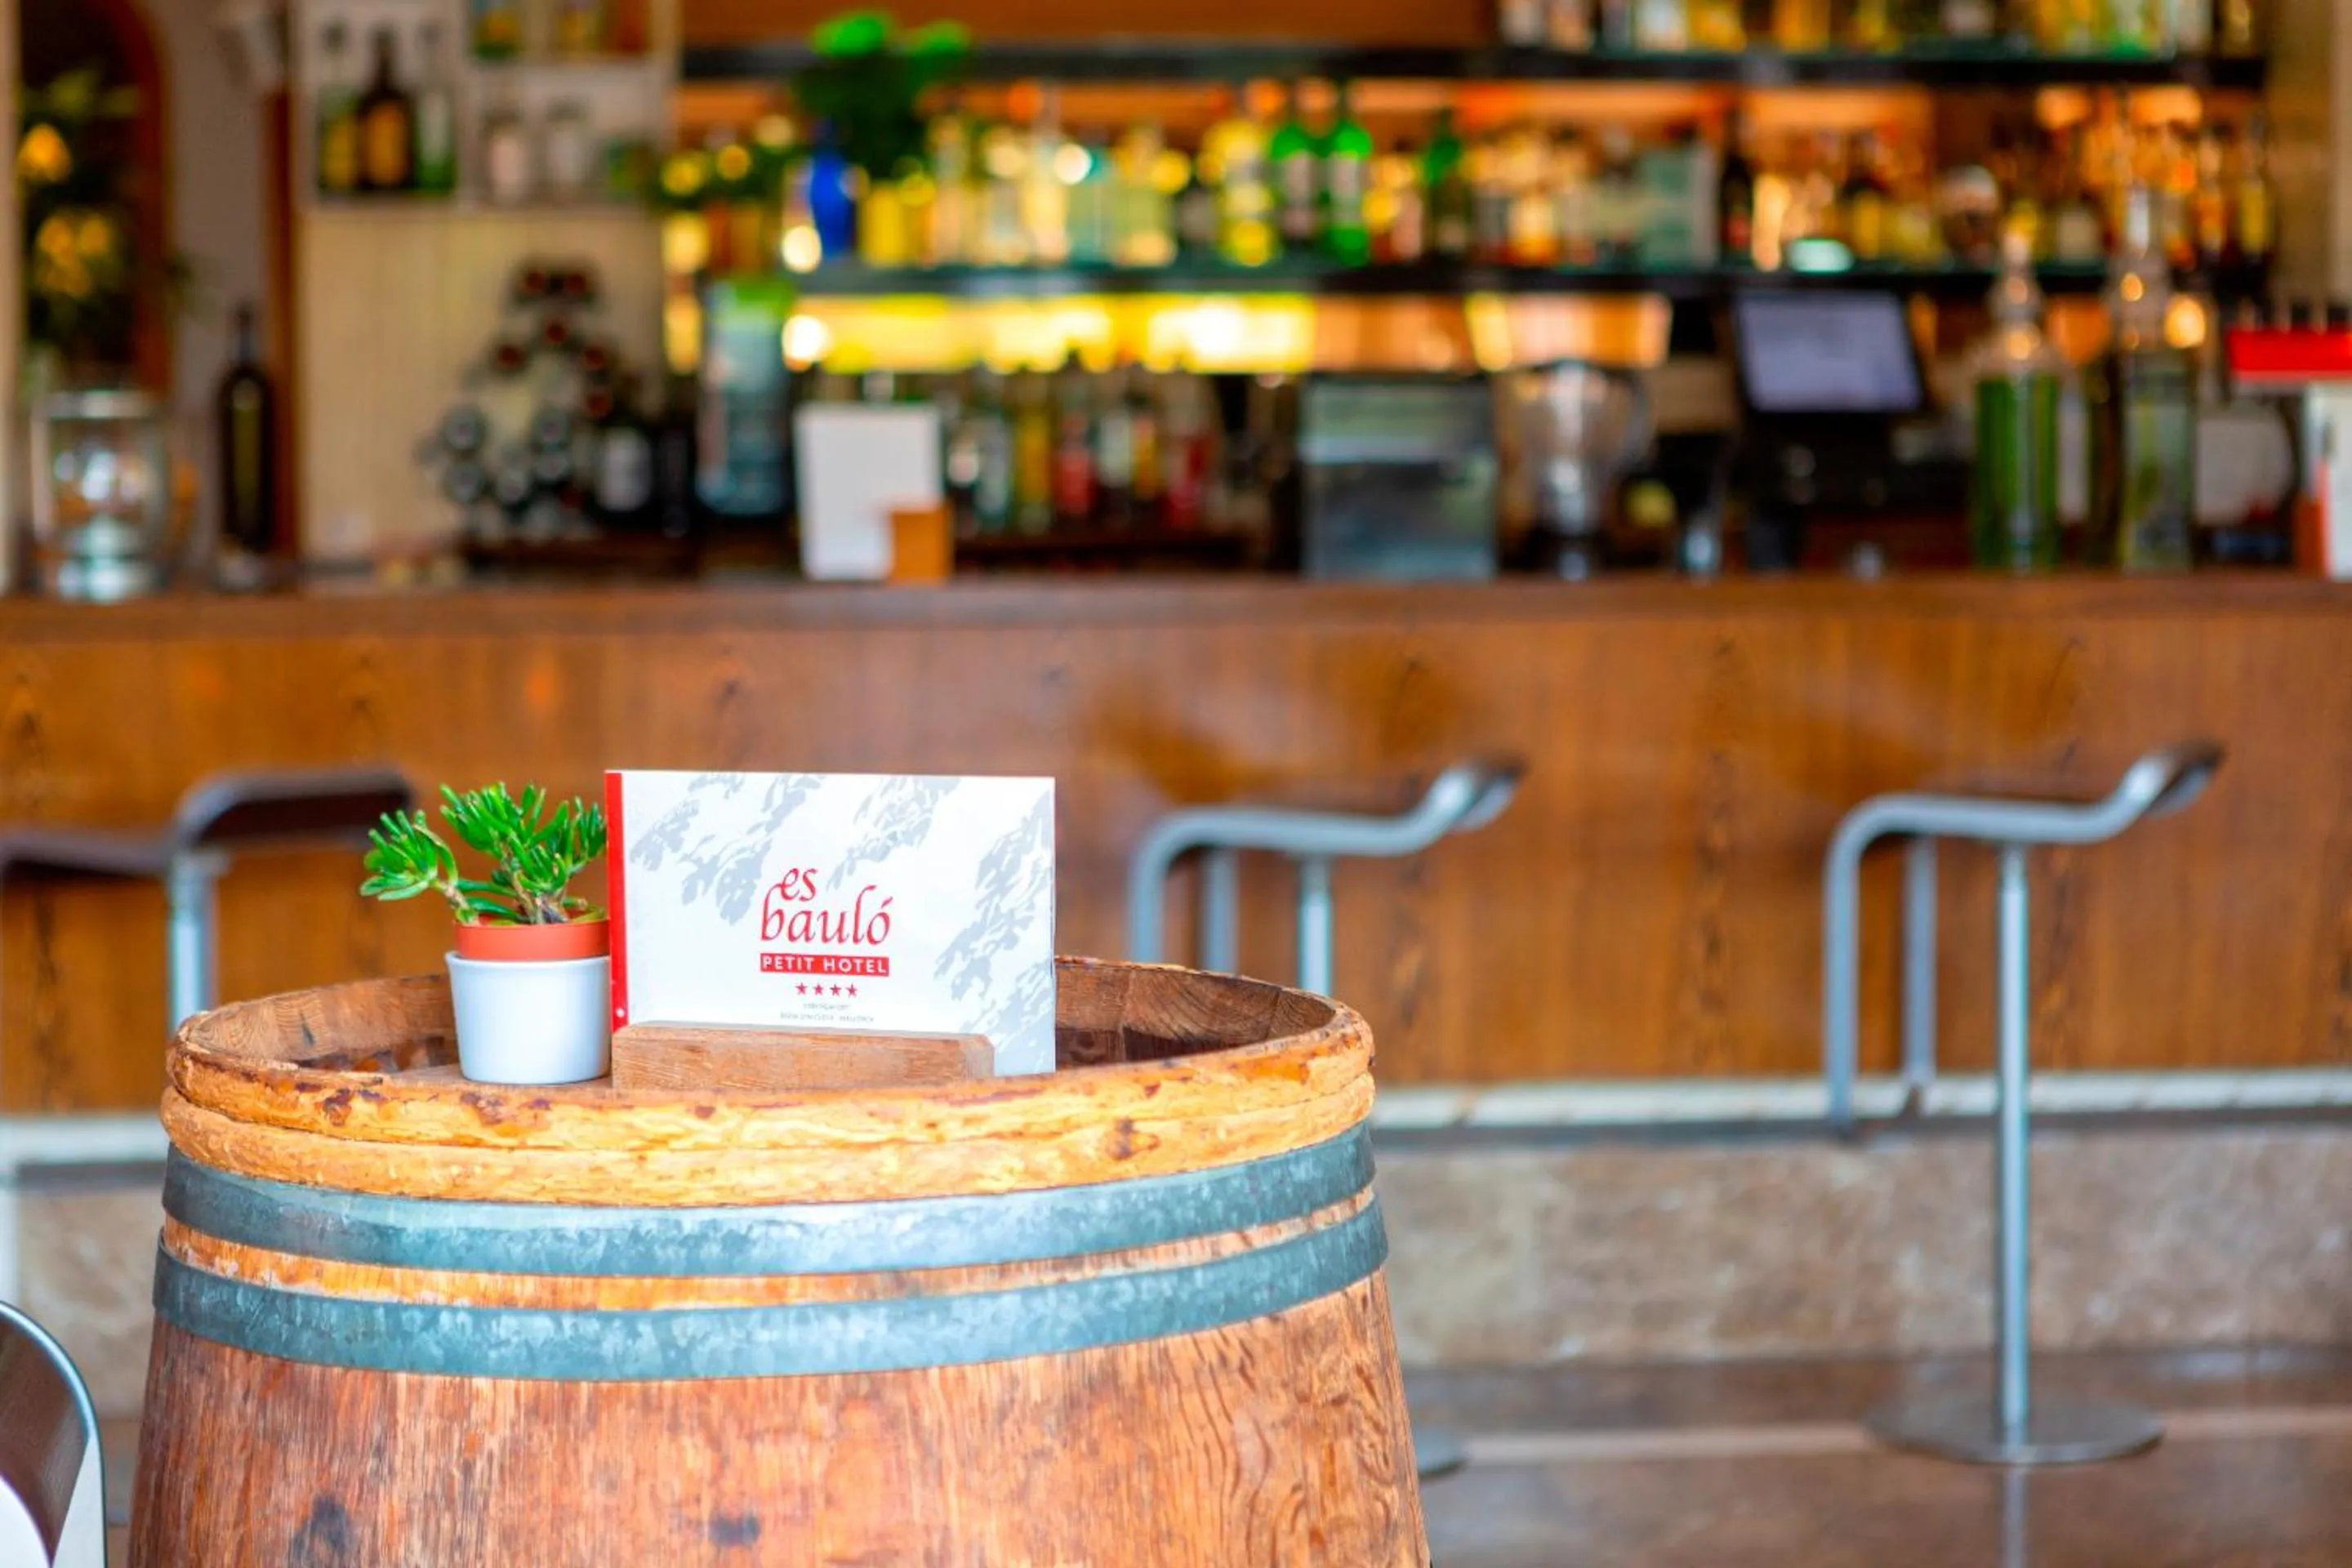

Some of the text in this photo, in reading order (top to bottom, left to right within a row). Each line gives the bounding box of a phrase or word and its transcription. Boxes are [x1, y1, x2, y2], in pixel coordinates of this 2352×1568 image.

[781, 868, 818, 902] es
[761, 884, 893, 945] bauló
[763, 956, 887, 973] PETIT HOTEL
